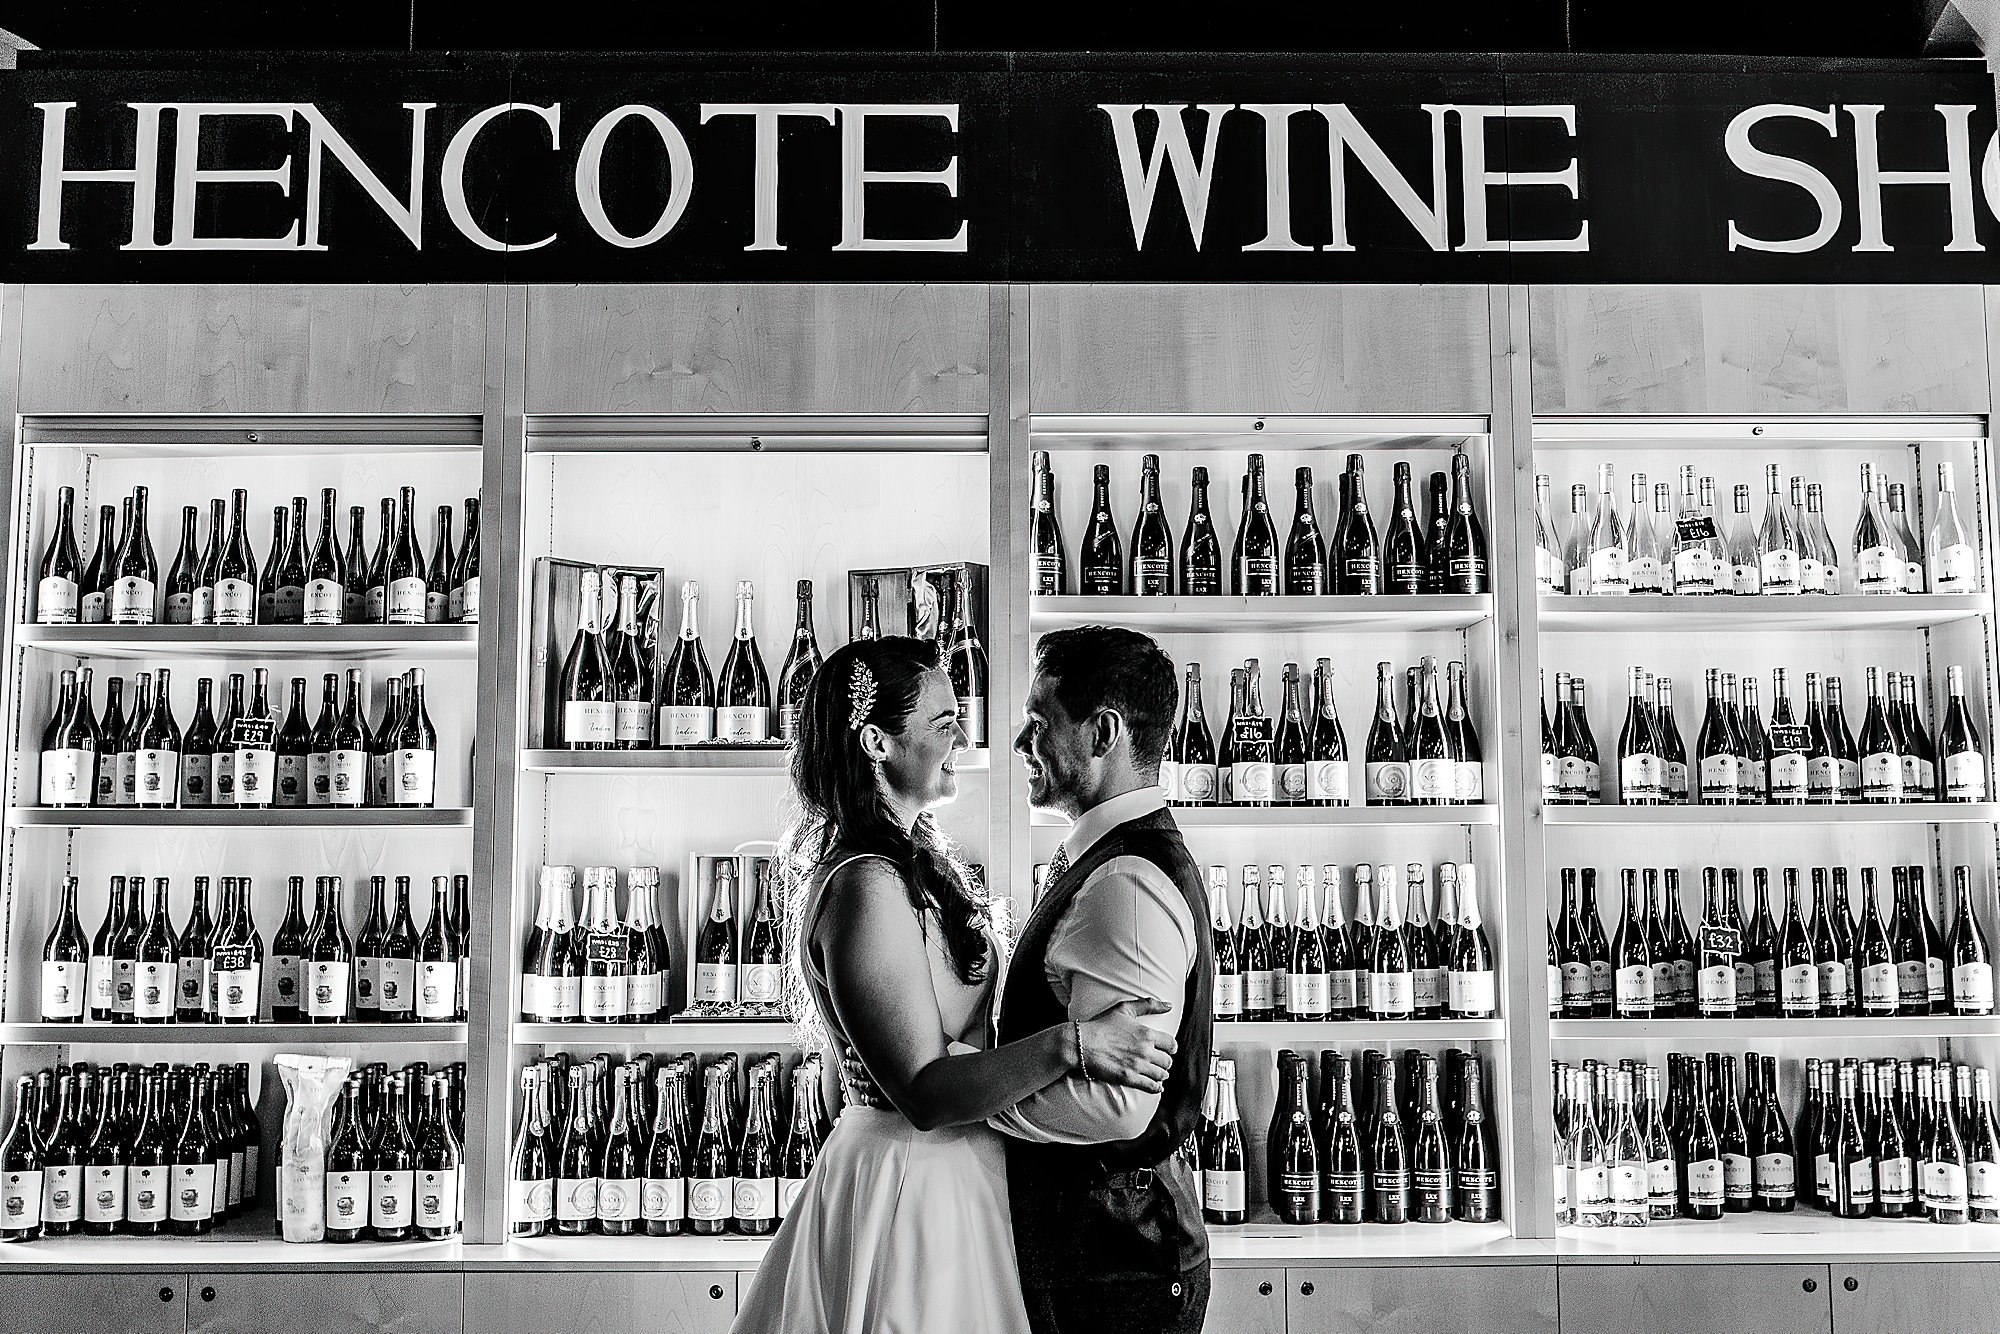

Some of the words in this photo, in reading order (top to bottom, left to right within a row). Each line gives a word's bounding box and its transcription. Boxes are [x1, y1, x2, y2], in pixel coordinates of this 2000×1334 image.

[27, 101, 969, 253] HENCOTE
[1097, 102, 1590, 253] WINE
[1725, 102, 2000, 253] SH
[1689, 527, 1710, 539] £16
[244, 729, 264, 742] £29
[1240, 726, 1263, 740] £16
[1782, 735, 1802, 748] £19
[1708, 932, 1734, 949] £32
[598, 946, 618, 959] £28
[223, 956, 245, 969] £38
